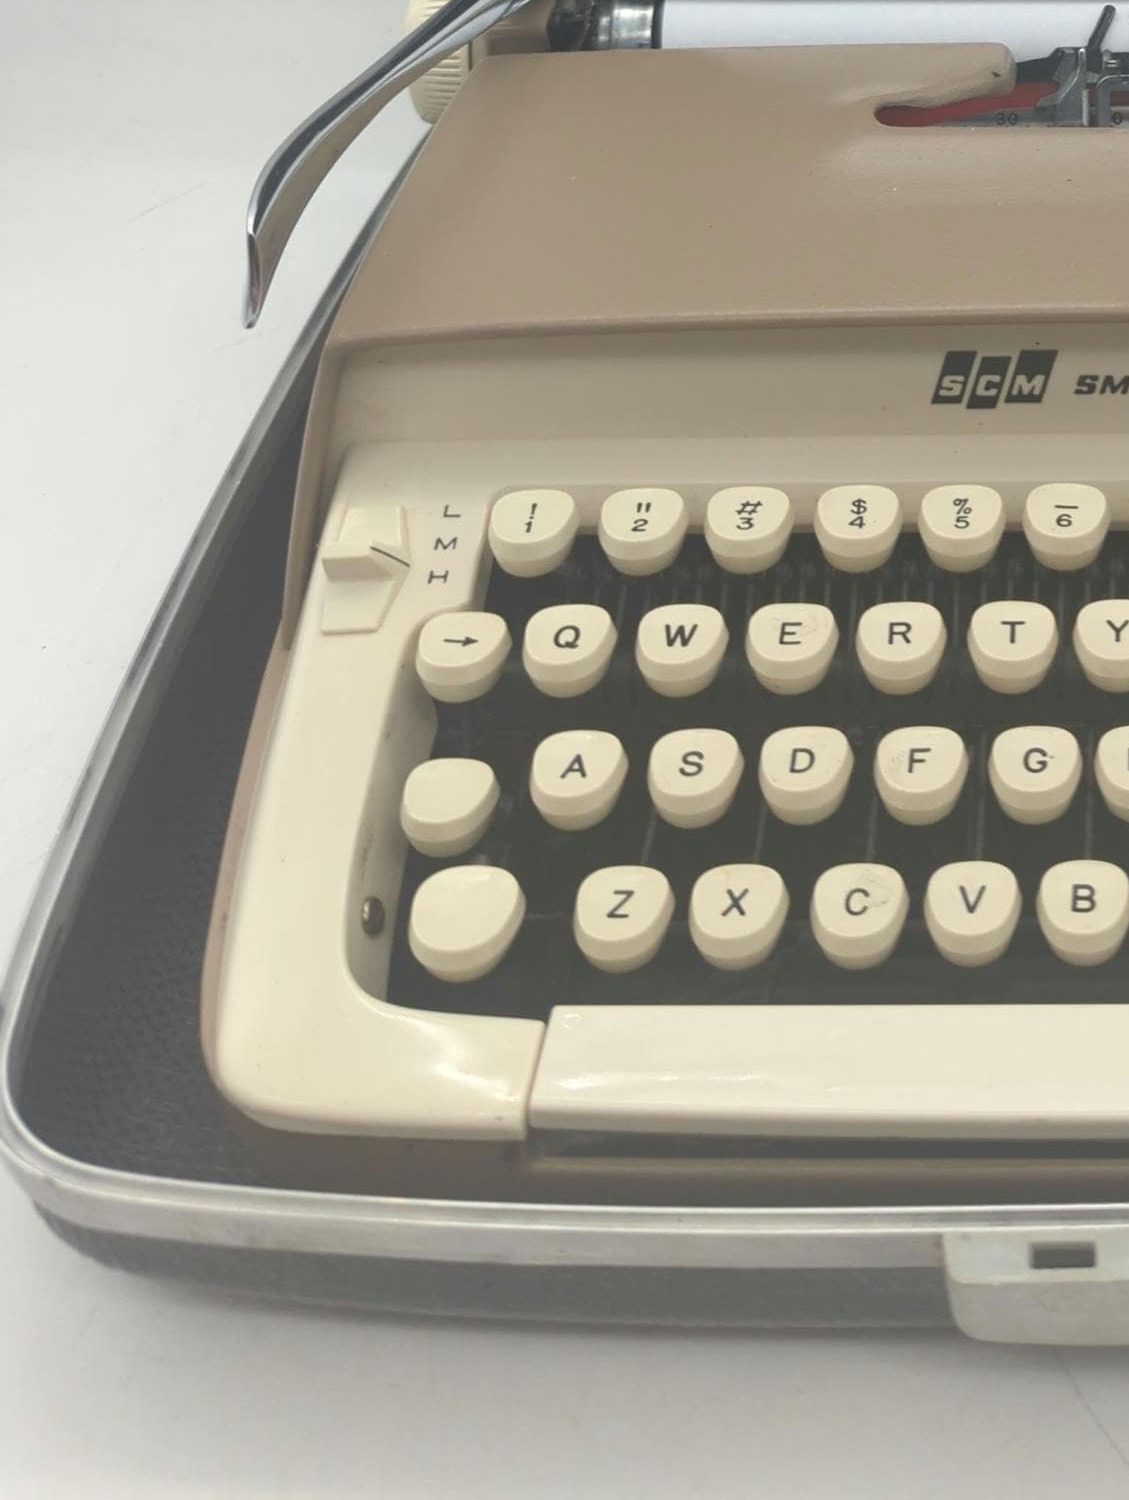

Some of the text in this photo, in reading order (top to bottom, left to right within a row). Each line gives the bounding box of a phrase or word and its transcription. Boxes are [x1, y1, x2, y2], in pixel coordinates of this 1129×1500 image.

[442, 504, 462, 519] L
[735, 500, 763, 516] #
[850, 498, 868, 516] $
[952, 497, 973, 515] %
[630, 518, 649, 533] 2
[735, 516, 755, 531] 3
[848, 515, 866, 529] 4
[953, 515, 970, 530] 5
[1055, 513, 1073, 528] 6
[433, 536, 458, 551] M
[427, 570, 449, 585] H
[553, 625, 581, 650] Q
[664, 623, 699, 648] W
[778, 621, 803, 646] E
[887, 621, 913, 645] R
[1000, 620, 1026, 645] T
[1106, 619, 1129, 643] Y
[559, 753, 587, 780] A
[678, 750, 705, 778] S
[789, 747, 816, 774] D
[907, 747, 932, 774] F
[1022, 747, 1048, 774] G
[606, 889, 635, 919] Z
[720, 888, 749, 917] X
[844, 887, 871, 917] C
[959, 885, 987, 914] V
[1070, 883, 1097, 914] B
